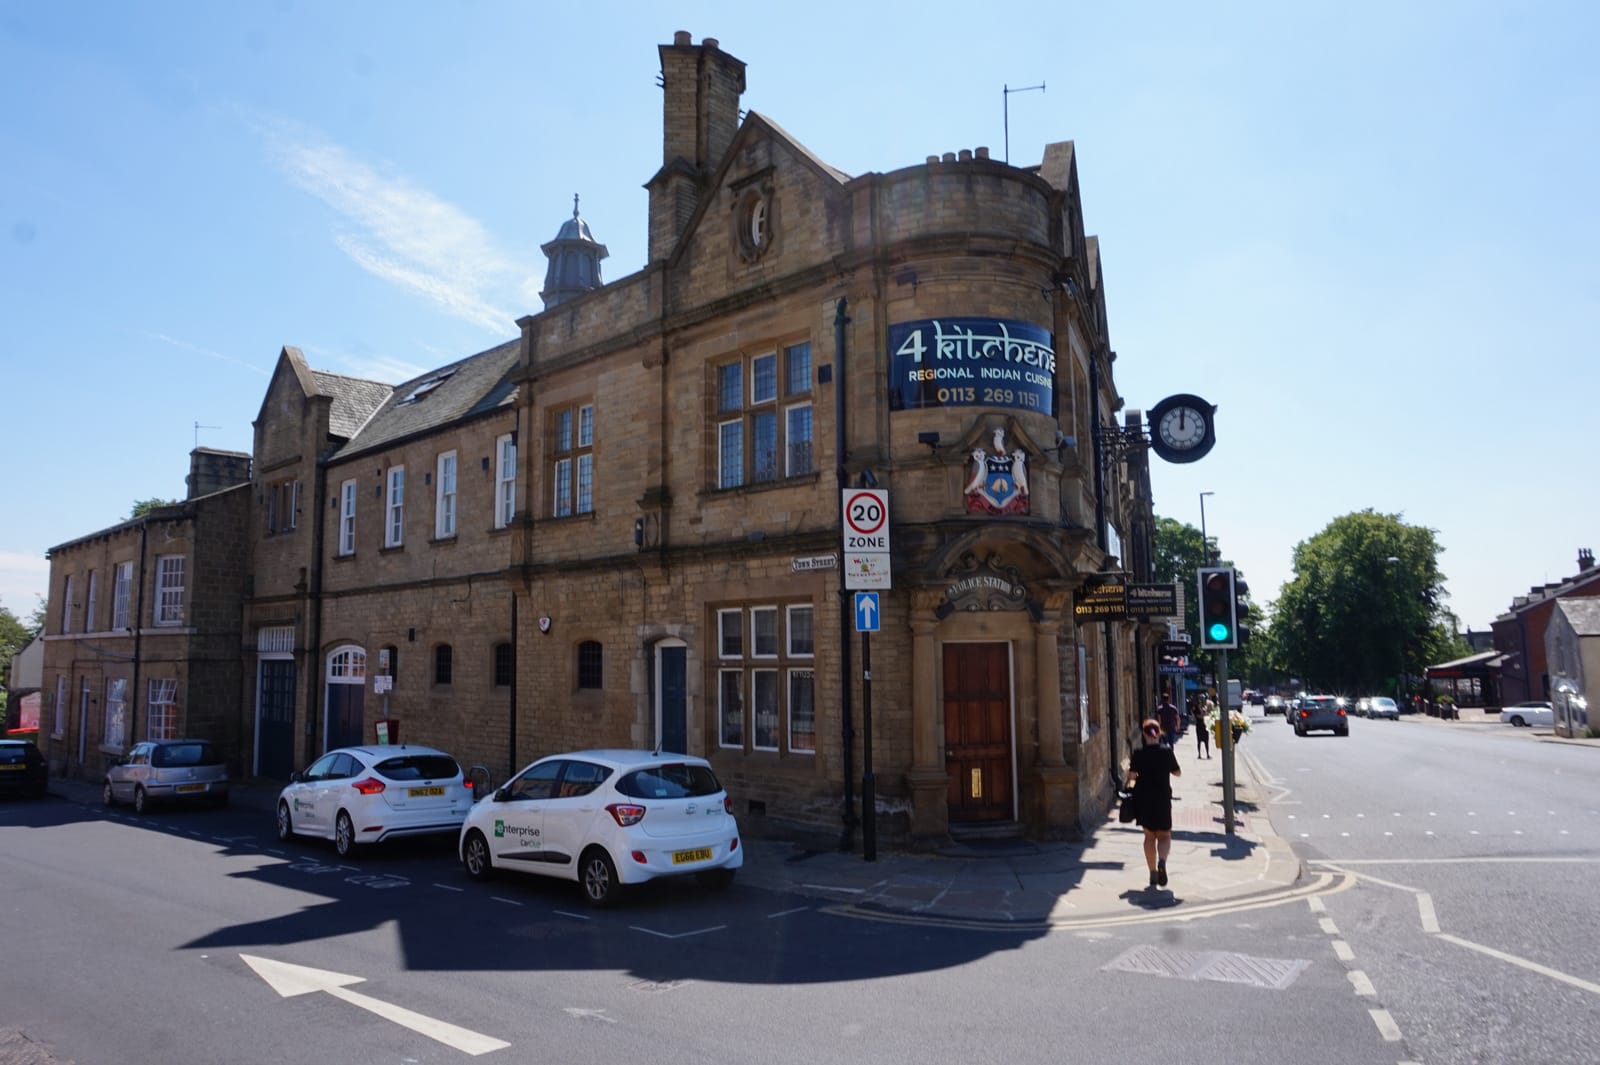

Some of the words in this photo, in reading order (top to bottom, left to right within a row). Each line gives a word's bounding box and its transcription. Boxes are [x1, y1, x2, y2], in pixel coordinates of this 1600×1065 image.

[896, 330, 927, 362] 4
[933, 320, 1056, 373] kitchens
[909, 368, 974, 381] REGIONAL
[981, 368, 1020, 380] INDIAN
[937, 387, 975, 402] 0113
[984, 388, 1013, 403] 269
[1018, 391, 1040, 407] 1151
[853, 505, 880, 521] 20
[849, 537, 885, 547] ZONE
[951, 576, 982, 593] POLICE
[1075, 606, 1092, 614] 0113
[1110, 605, 1125, 613] 1151
[496, 822, 540, 837] enterprise
